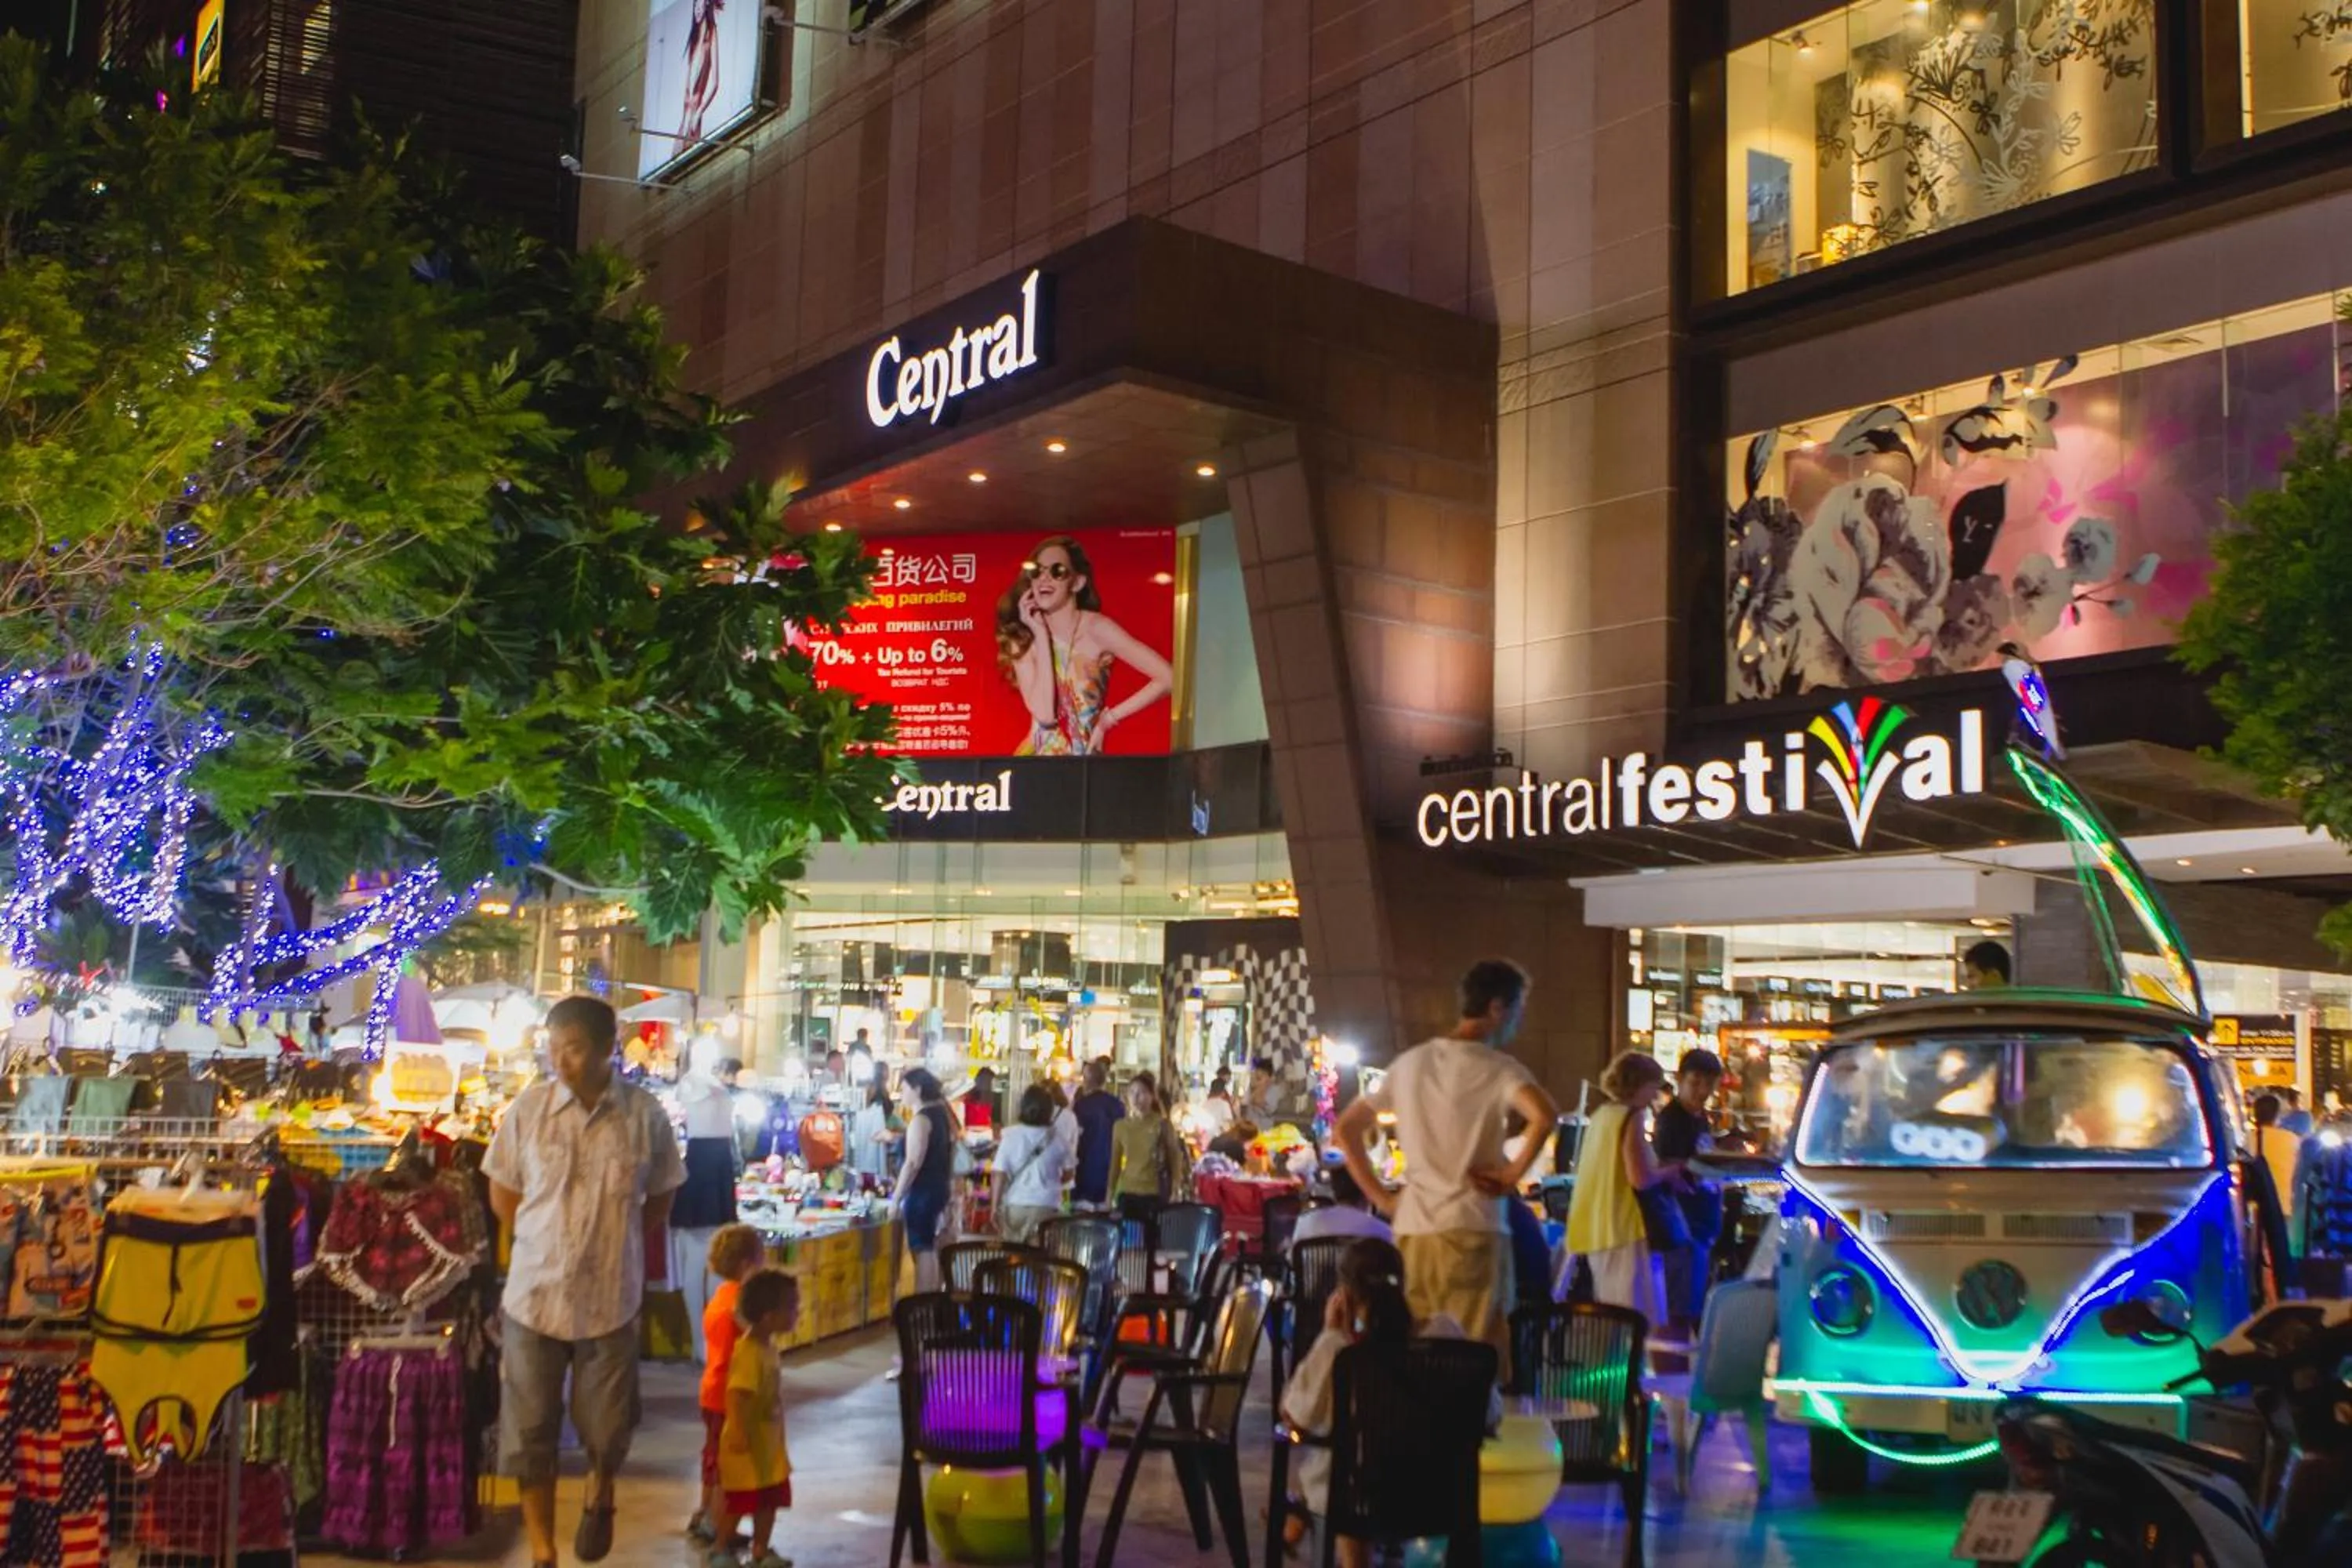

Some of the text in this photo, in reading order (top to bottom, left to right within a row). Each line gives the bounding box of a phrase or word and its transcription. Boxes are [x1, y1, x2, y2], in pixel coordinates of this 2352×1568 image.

[866, 269, 1039, 426] Central
[898, 590, 967, 607] paradise
[877, 647, 903, 667] Up
[907, 647, 927, 663] to
[931, 637, 964, 663] 6%
